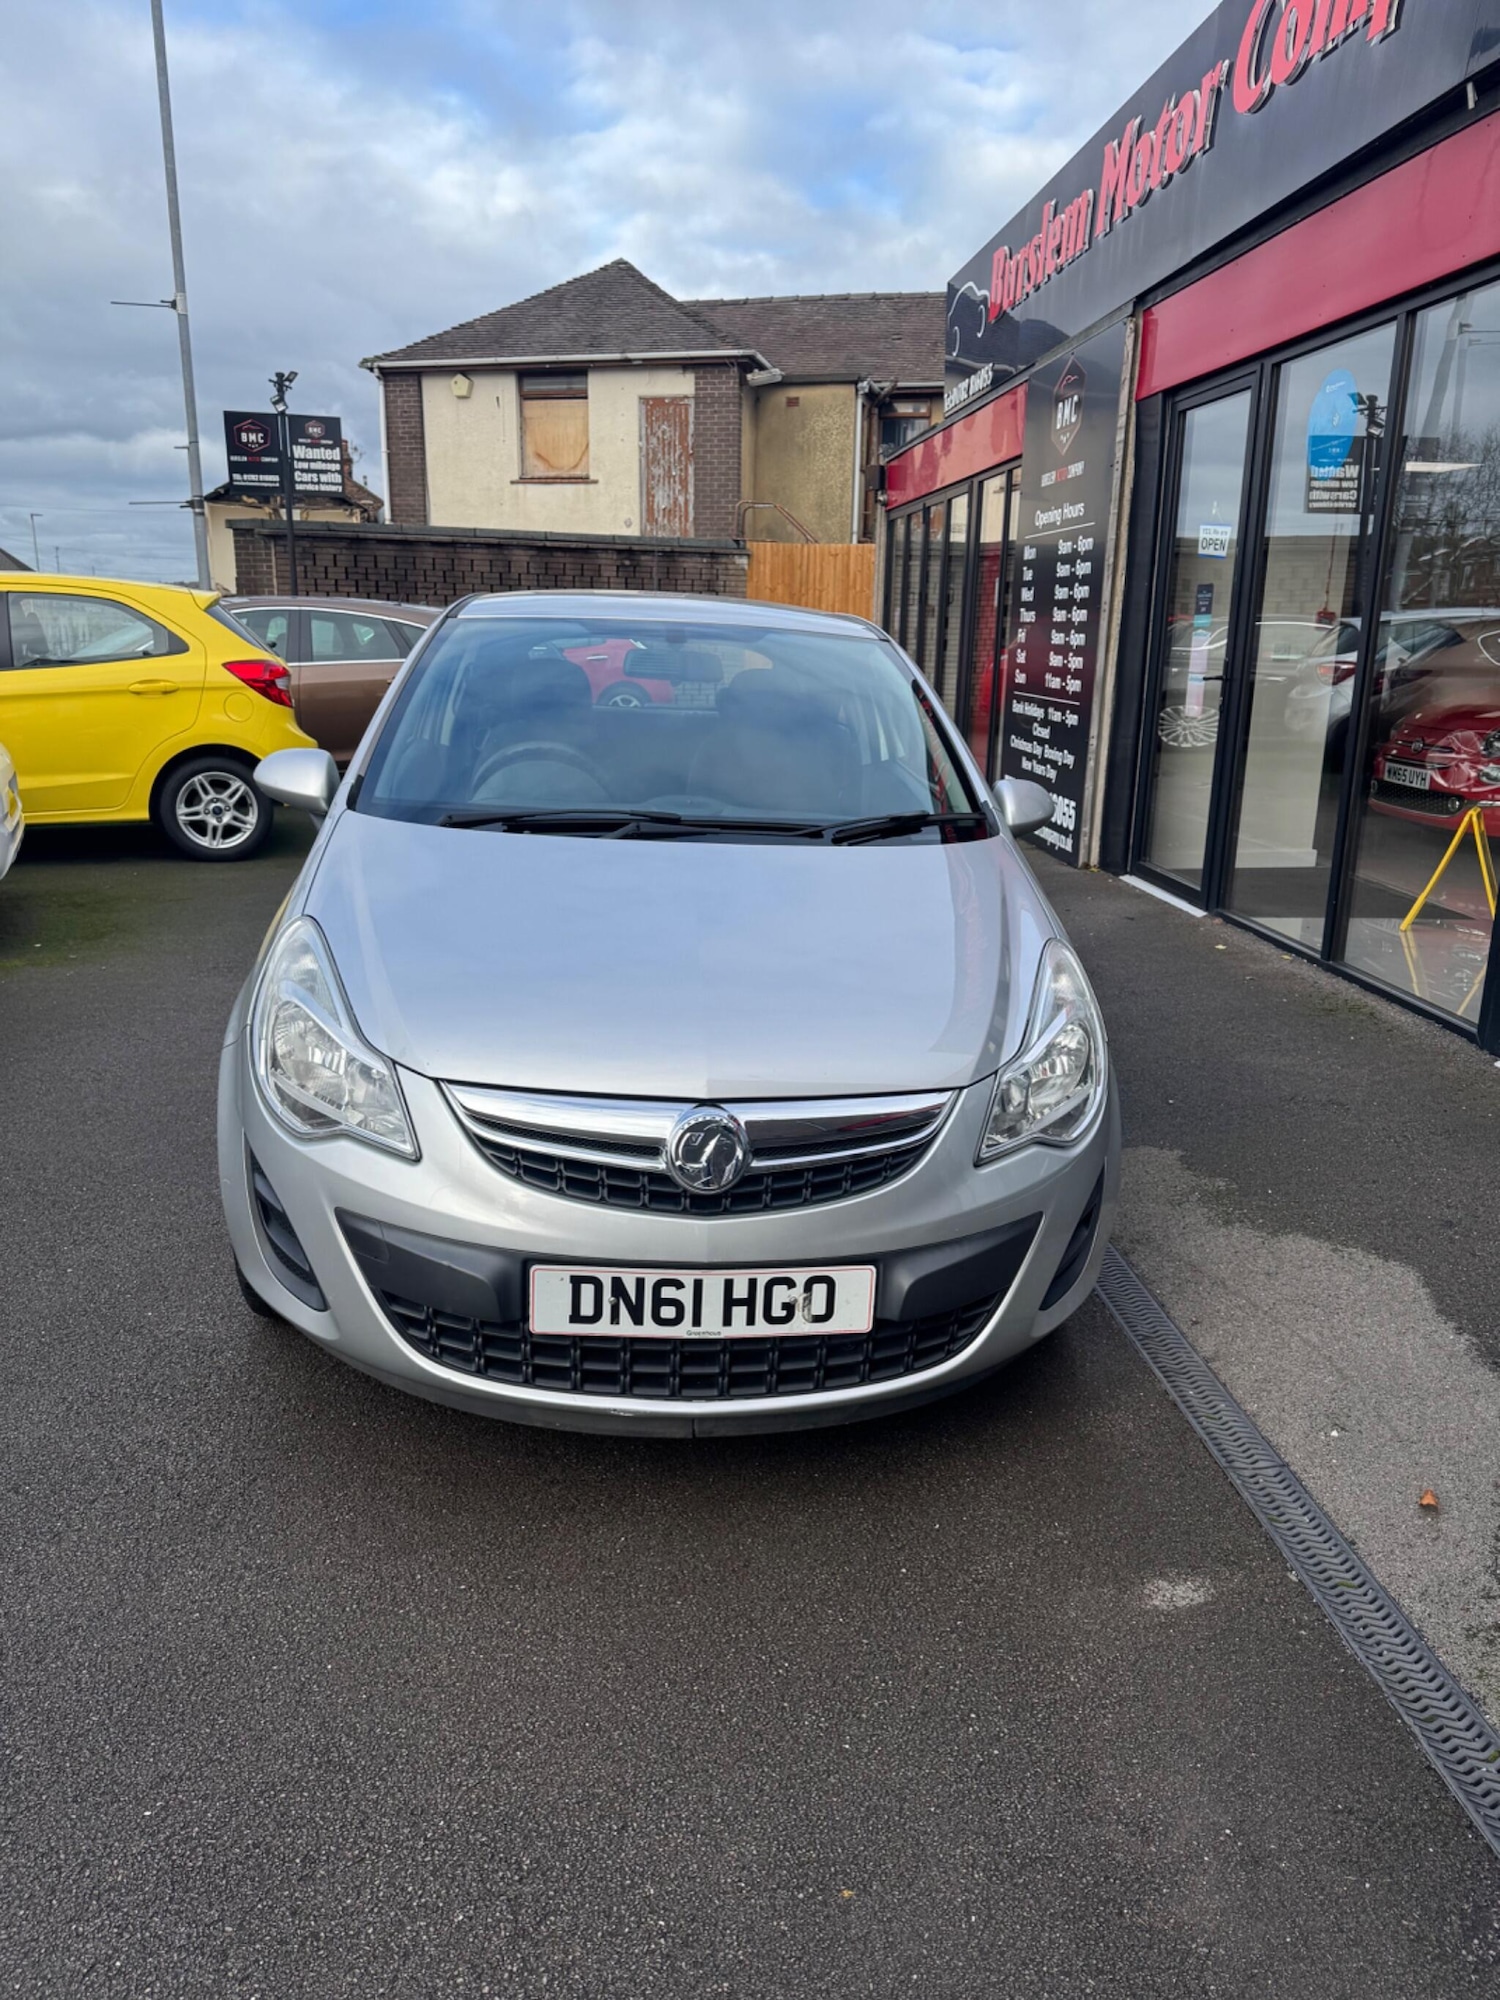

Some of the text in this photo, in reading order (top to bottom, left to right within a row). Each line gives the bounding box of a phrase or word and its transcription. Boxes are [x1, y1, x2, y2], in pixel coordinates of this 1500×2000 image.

[988, 189, 1093, 323] Burslem
[1094, 60, 1229, 238] Motor
[1056, 395, 1079, 430] BMC
[241, 432, 265, 444] BMC
[292, 445, 341, 461] Wanted
[294, 460, 341, 472] Low mileage
[294, 470, 342, 484] Cars with
[319, 484, 342, 493] history
[1035, 503, 1084, 529] Opening Hours
[1023, 545, 1036, 560] Mon
[1058, 539, 1072, 555] 9am
[1078, 535, 1094, 555] 6pm
[1201, 537, 1226, 551] OPEN
[1023, 566, 1033, 581] Tue
[1056, 561, 1070, 578] 9am
[1076, 559, 1091, 579] 6pm
[1021, 587, 1034, 602] Wed
[1054, 584, 1069, 600] 9am
[1074, 582, 1089, 602] 6pm
[1020, 608, 1036, 622] Thurs
[1053, 606, 1067, 622] 9am
[1072, 606, 1087, 626] 6pm
[1018, 628, 1026, 643] Fri
[1051, 629, 1065, 645] 9am
[1070, 629, 1086, 649] 6pm
[1016, 649, 1026, 663] Sat
[1049, 651, 1063, 667] 9am
[1068, 652, 1083, 672] 5pm
[1015, 669, 1026, 684] Sun
[1045, 672, 1061, 689] 11am
[1066, 675, 1082, 695] 5pm
[1012, 699, 1024, 714] Bank
[1024, 702, 1045, 721] Holidays
[1048, 706, 1062, 722] 11am
[1066, 710, 1079, 728] 5pm
[1032, 722, 1050, 740] Closed
[1010, 734, 1075, 769] Christmas Day Boxing Day
[1022, 756, 1032, 771] New
[1046, 764, 1057, 783] Day
[1409, 769, 1428, 787] UYH
[569, 1275, 836, 1327] DN61 HGO
